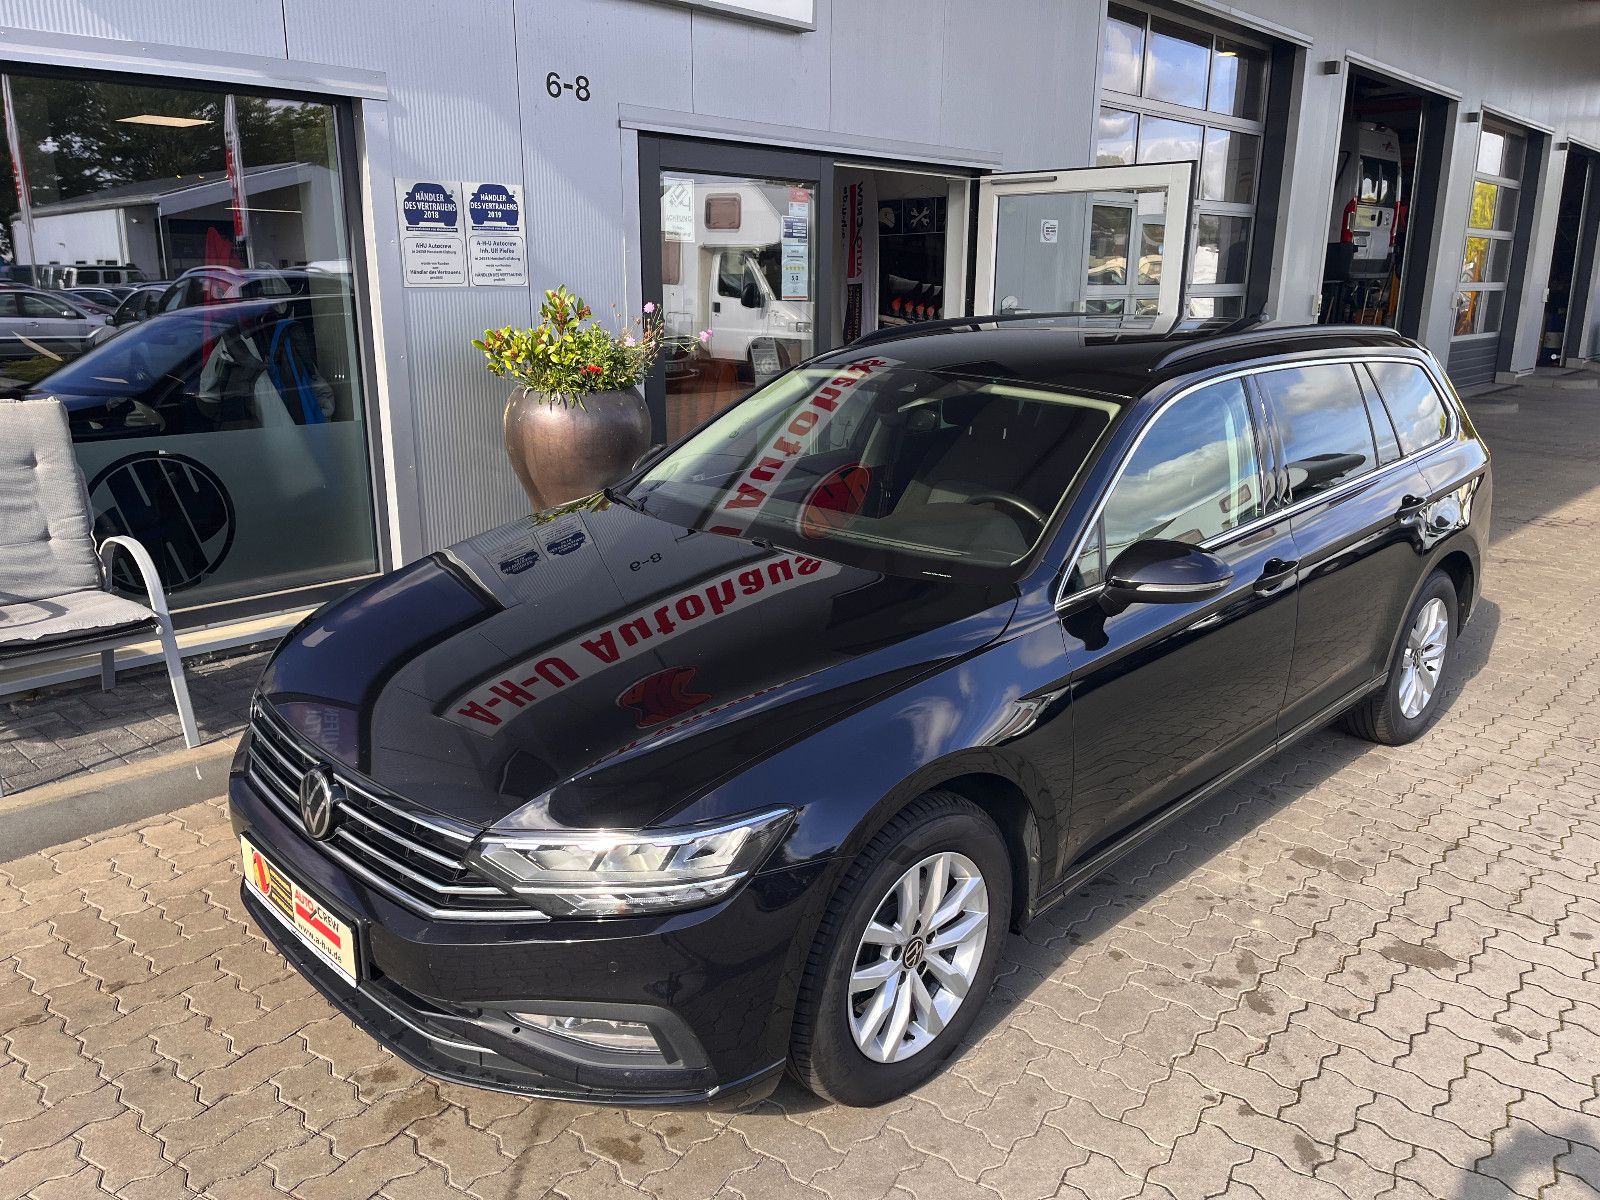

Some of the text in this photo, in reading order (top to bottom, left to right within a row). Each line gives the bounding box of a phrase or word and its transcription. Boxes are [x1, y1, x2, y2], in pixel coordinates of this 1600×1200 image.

[546, 71, 591, 101] 6-8
[415, 191, 445, 202] HÄNDLER
[480, 193, 507, 202] HÄNDLER
[404, 201, 456, 211] DES VERTRAUENS
[482, 202, 518, 210] VERTRAUENS
[423, 211, 439, 219] 2018
